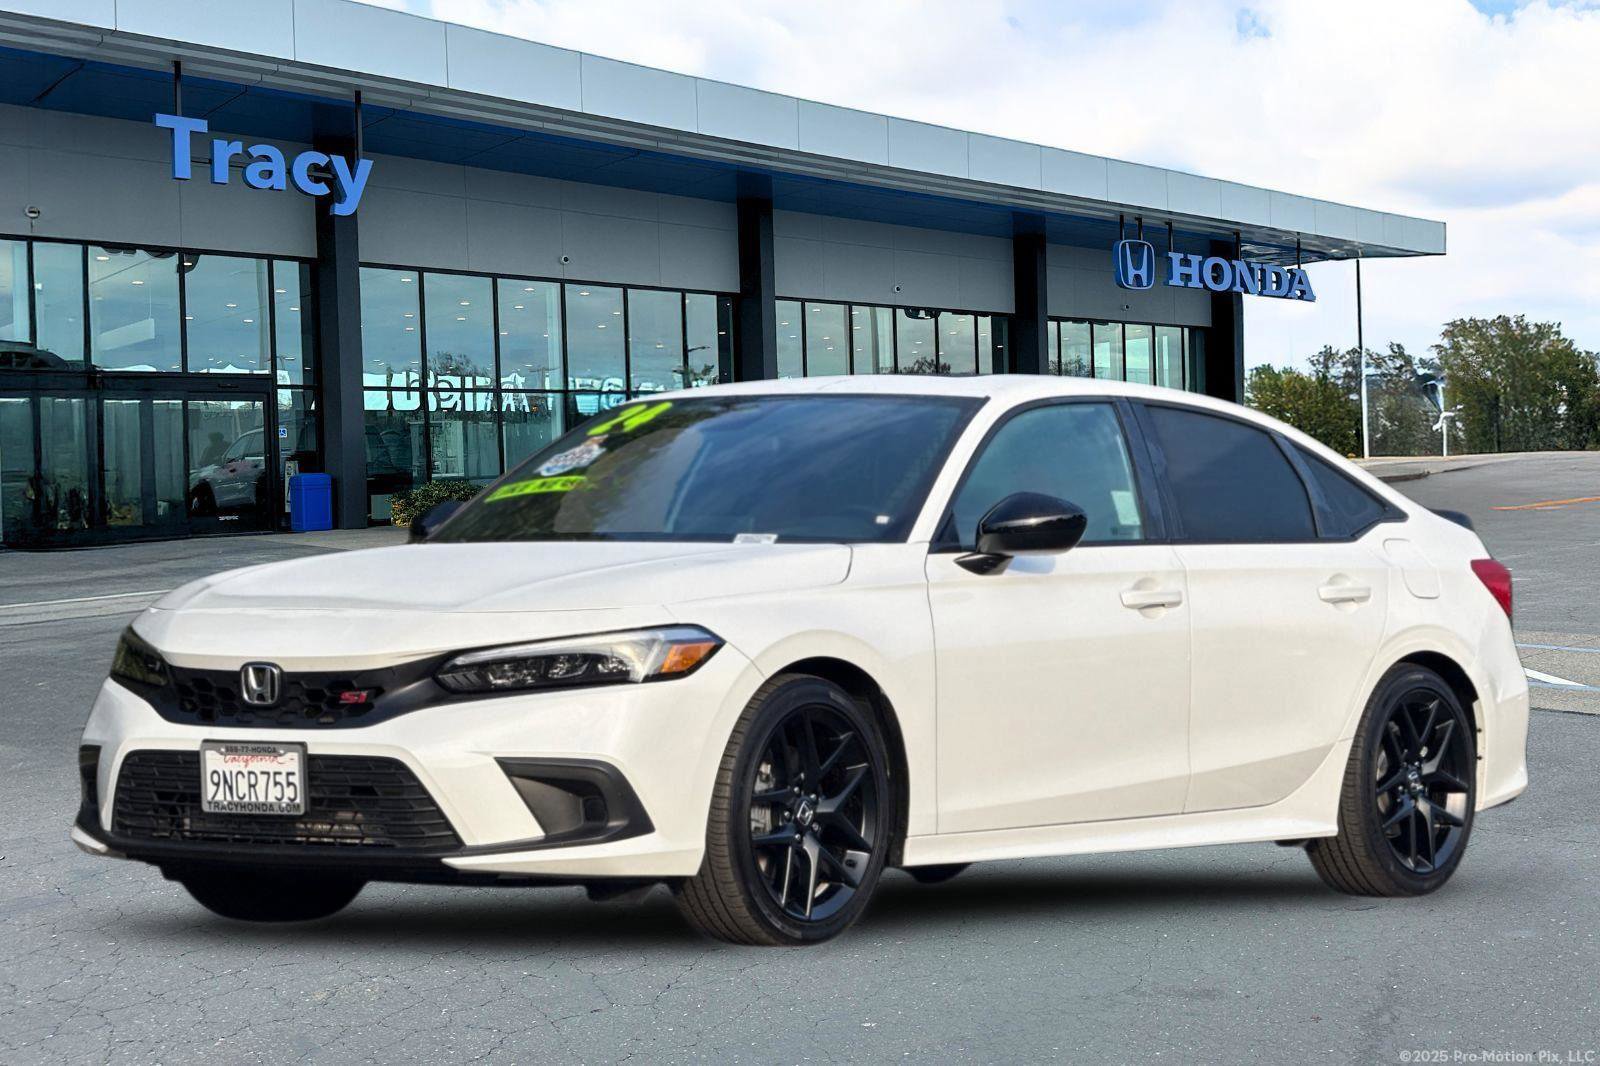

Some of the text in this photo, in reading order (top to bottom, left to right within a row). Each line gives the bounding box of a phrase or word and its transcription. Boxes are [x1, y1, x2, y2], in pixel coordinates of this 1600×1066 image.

[155, 113, 374, 216] Tracy
[1167, 251, 1317, 301] HONDA
[207, 801, 301, 813] TRACYHONDA.COM
[210, 770, 298, 803] 9NCR755
